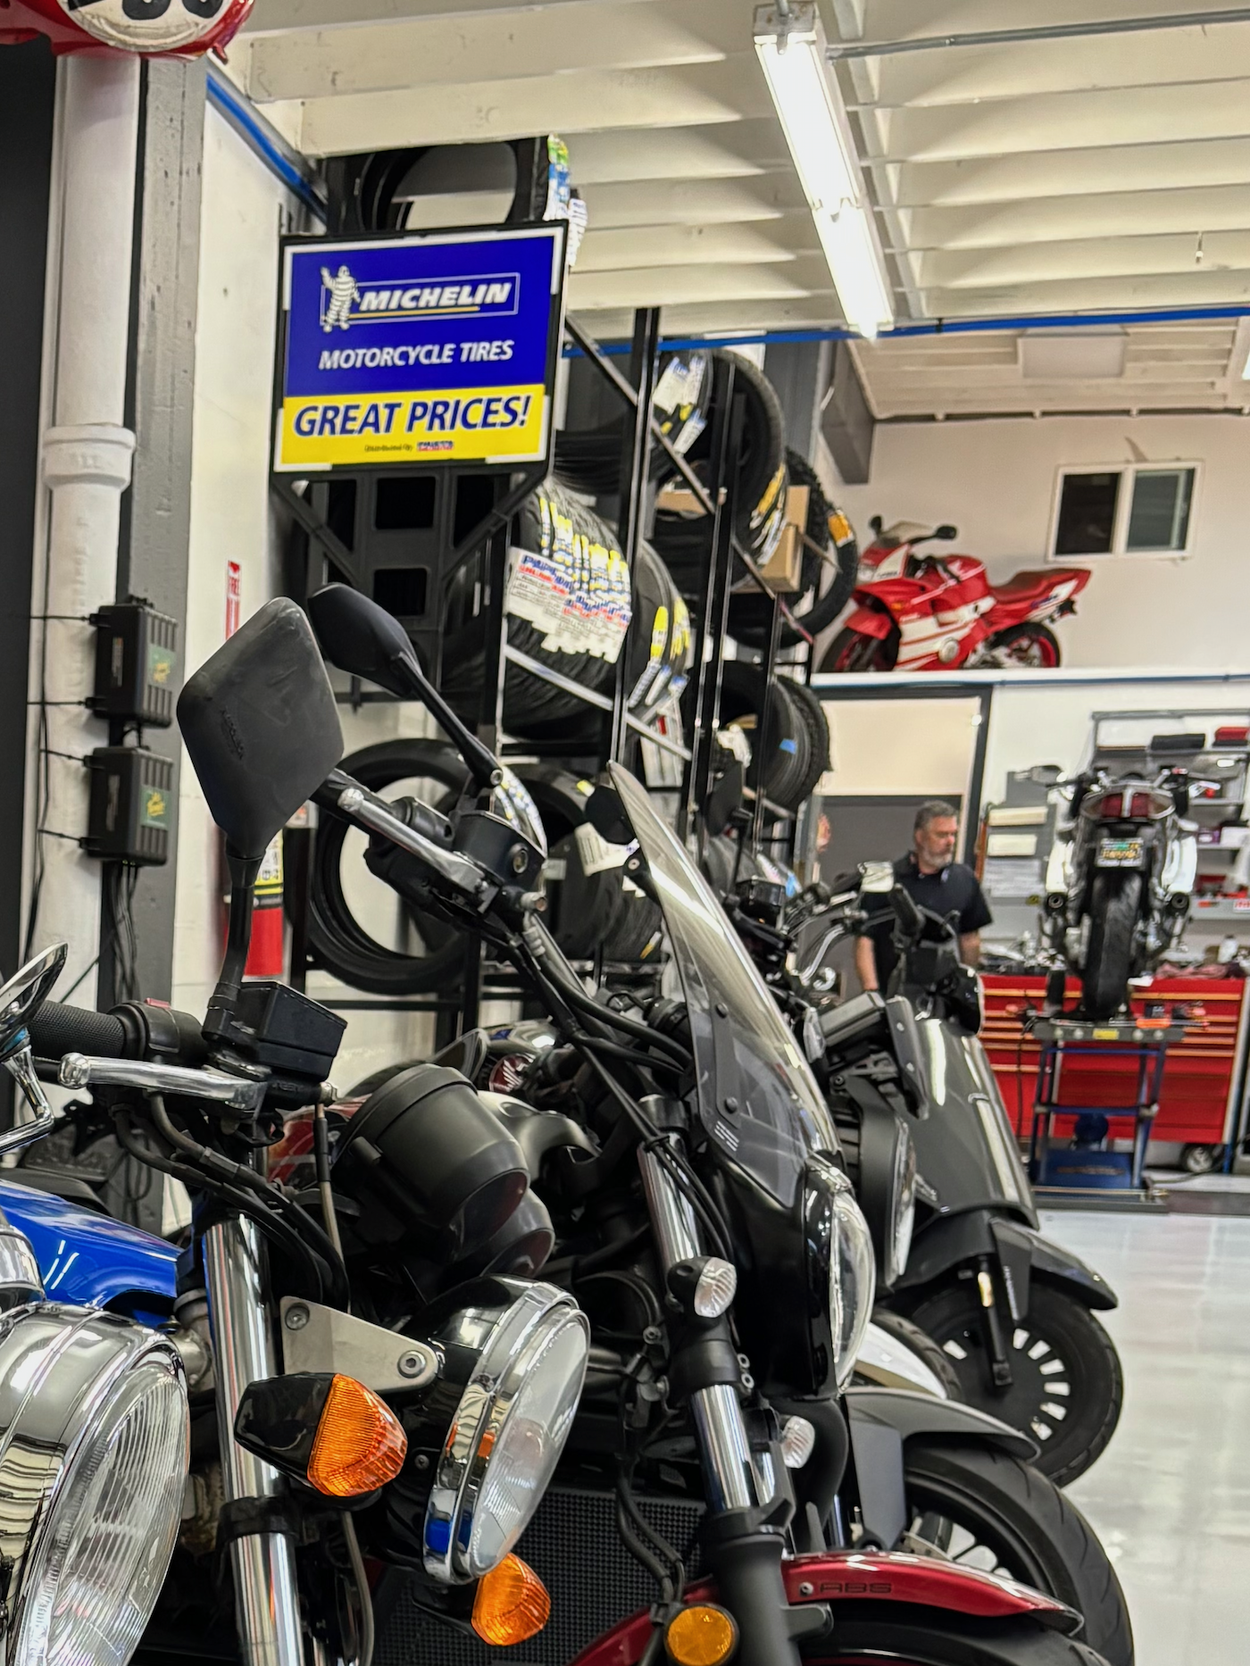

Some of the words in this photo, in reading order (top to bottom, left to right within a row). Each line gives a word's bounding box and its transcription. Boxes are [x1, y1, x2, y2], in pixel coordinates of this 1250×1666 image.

[358, 283, 513, 311] MICHELIN
[317, 343, 456, 370] MOTORCYCLE
[459, 340, 515, 363] TIRES
[293, 401, 402, 437] GREAT
[405, 395, 532, 433] PRICES!
[819, 1582, 892, 1594] ABS
